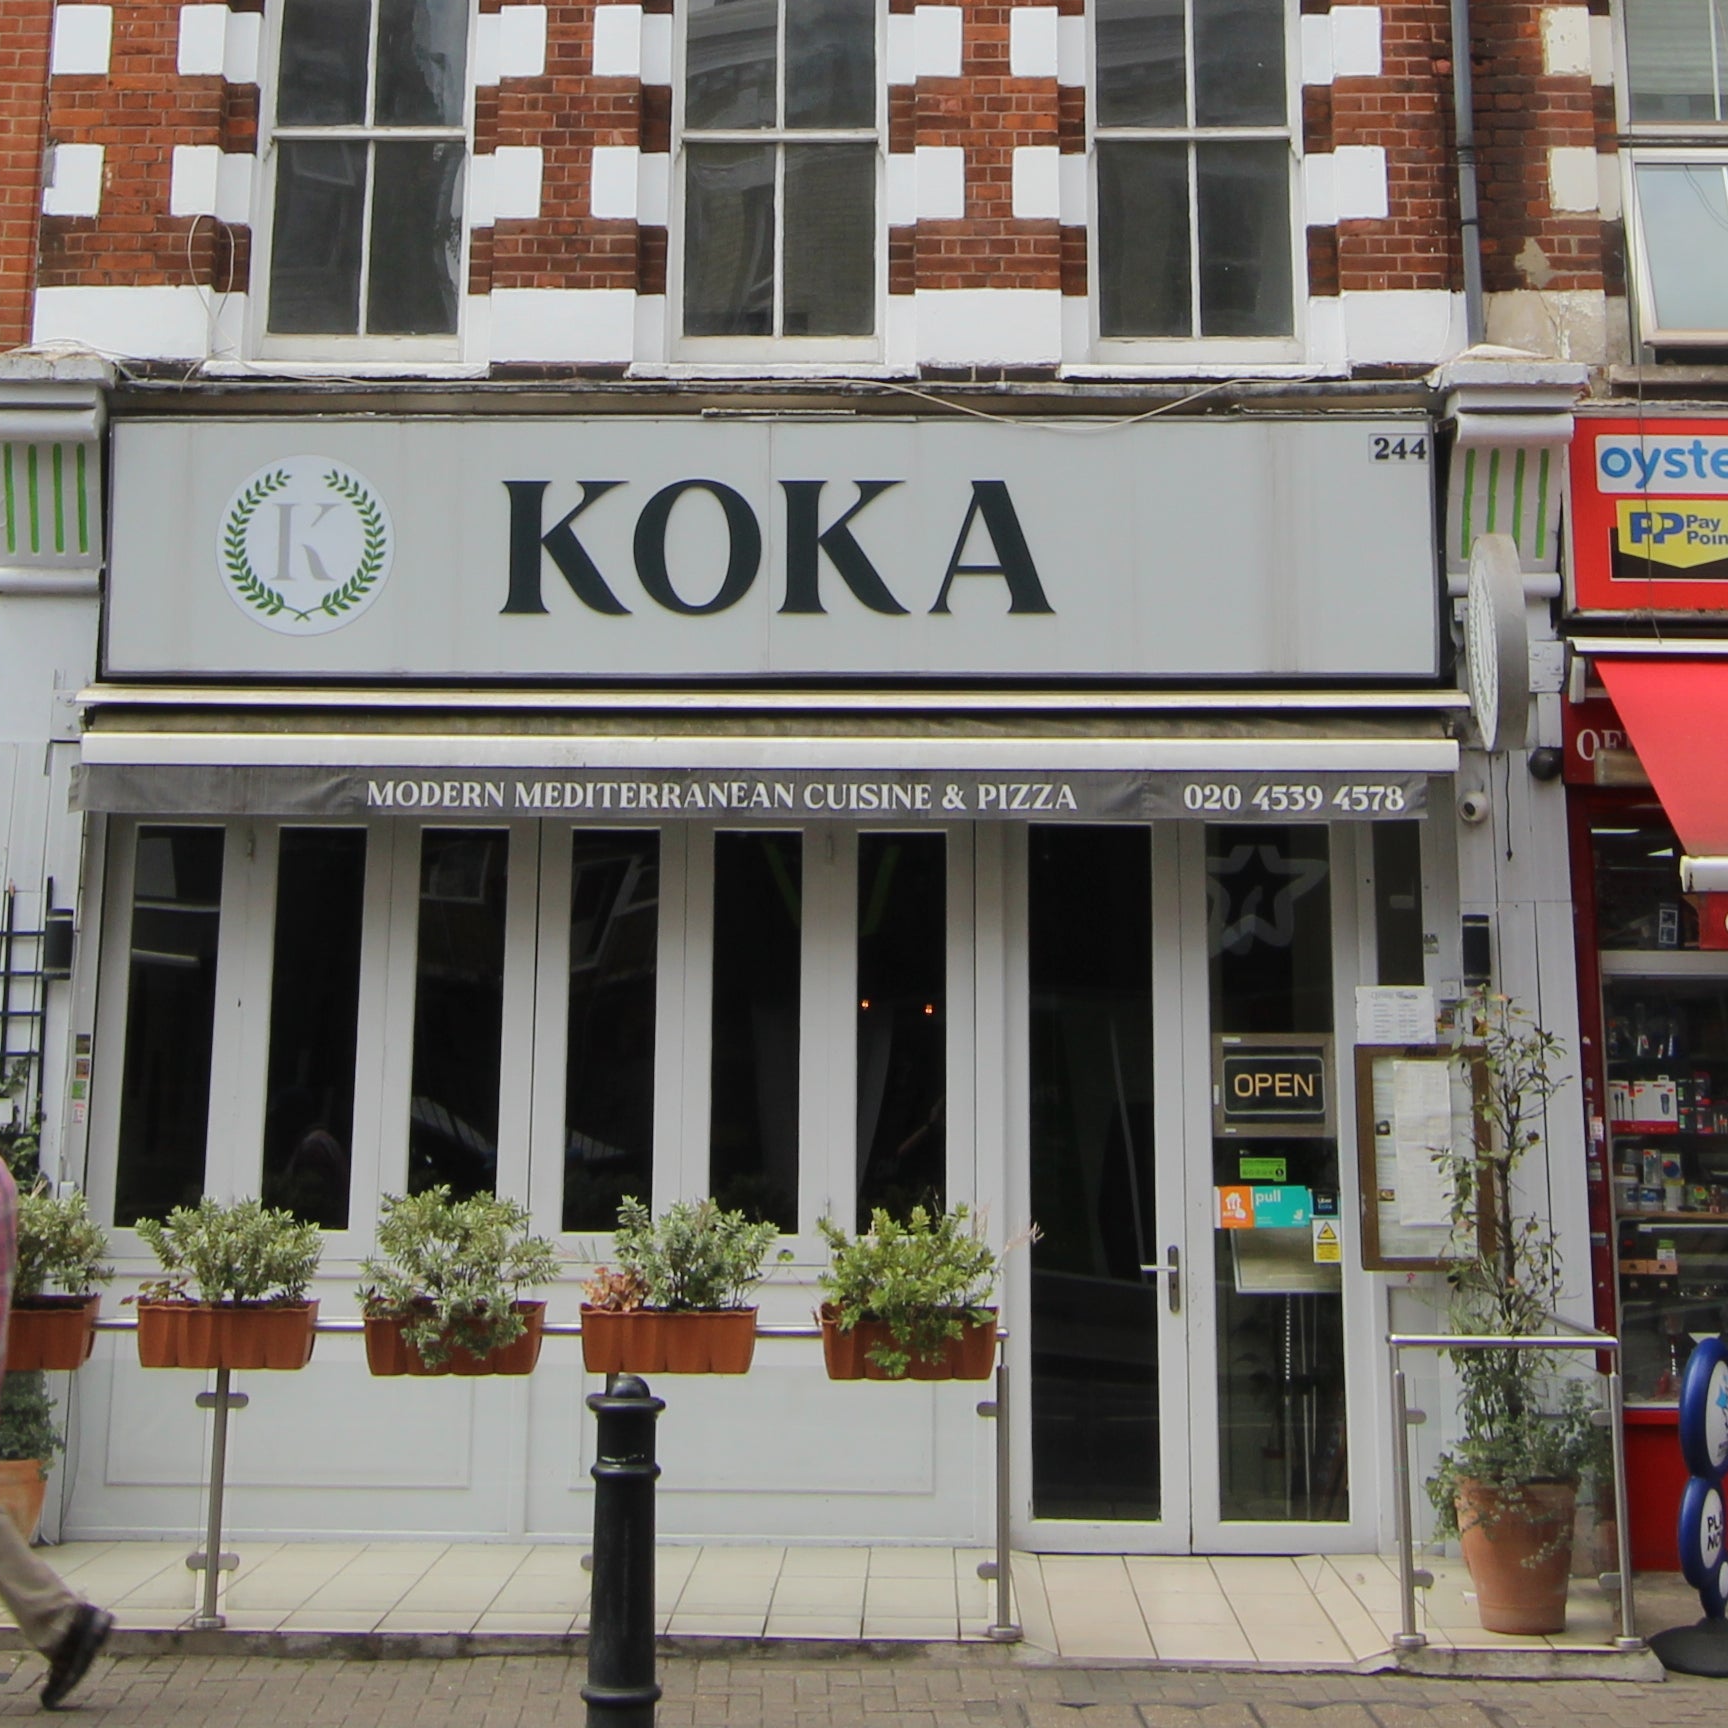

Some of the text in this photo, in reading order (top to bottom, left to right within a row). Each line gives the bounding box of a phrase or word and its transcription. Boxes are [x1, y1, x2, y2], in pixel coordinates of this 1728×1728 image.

[1374, 437, 1427, 461] 244
[1686, 514, 1721, 534] Pay
[270, 503, 343, 582] K
[499, 478, 1056, 616] KOKA
[367, 779, 1405, 813] MODERN MEDITERRANEAN CUISINE & PIZZA 020 4539 4578
[1234, 1073, 1313, 1097] OPEN
[1255, 1189, 1282, 1207] pull
